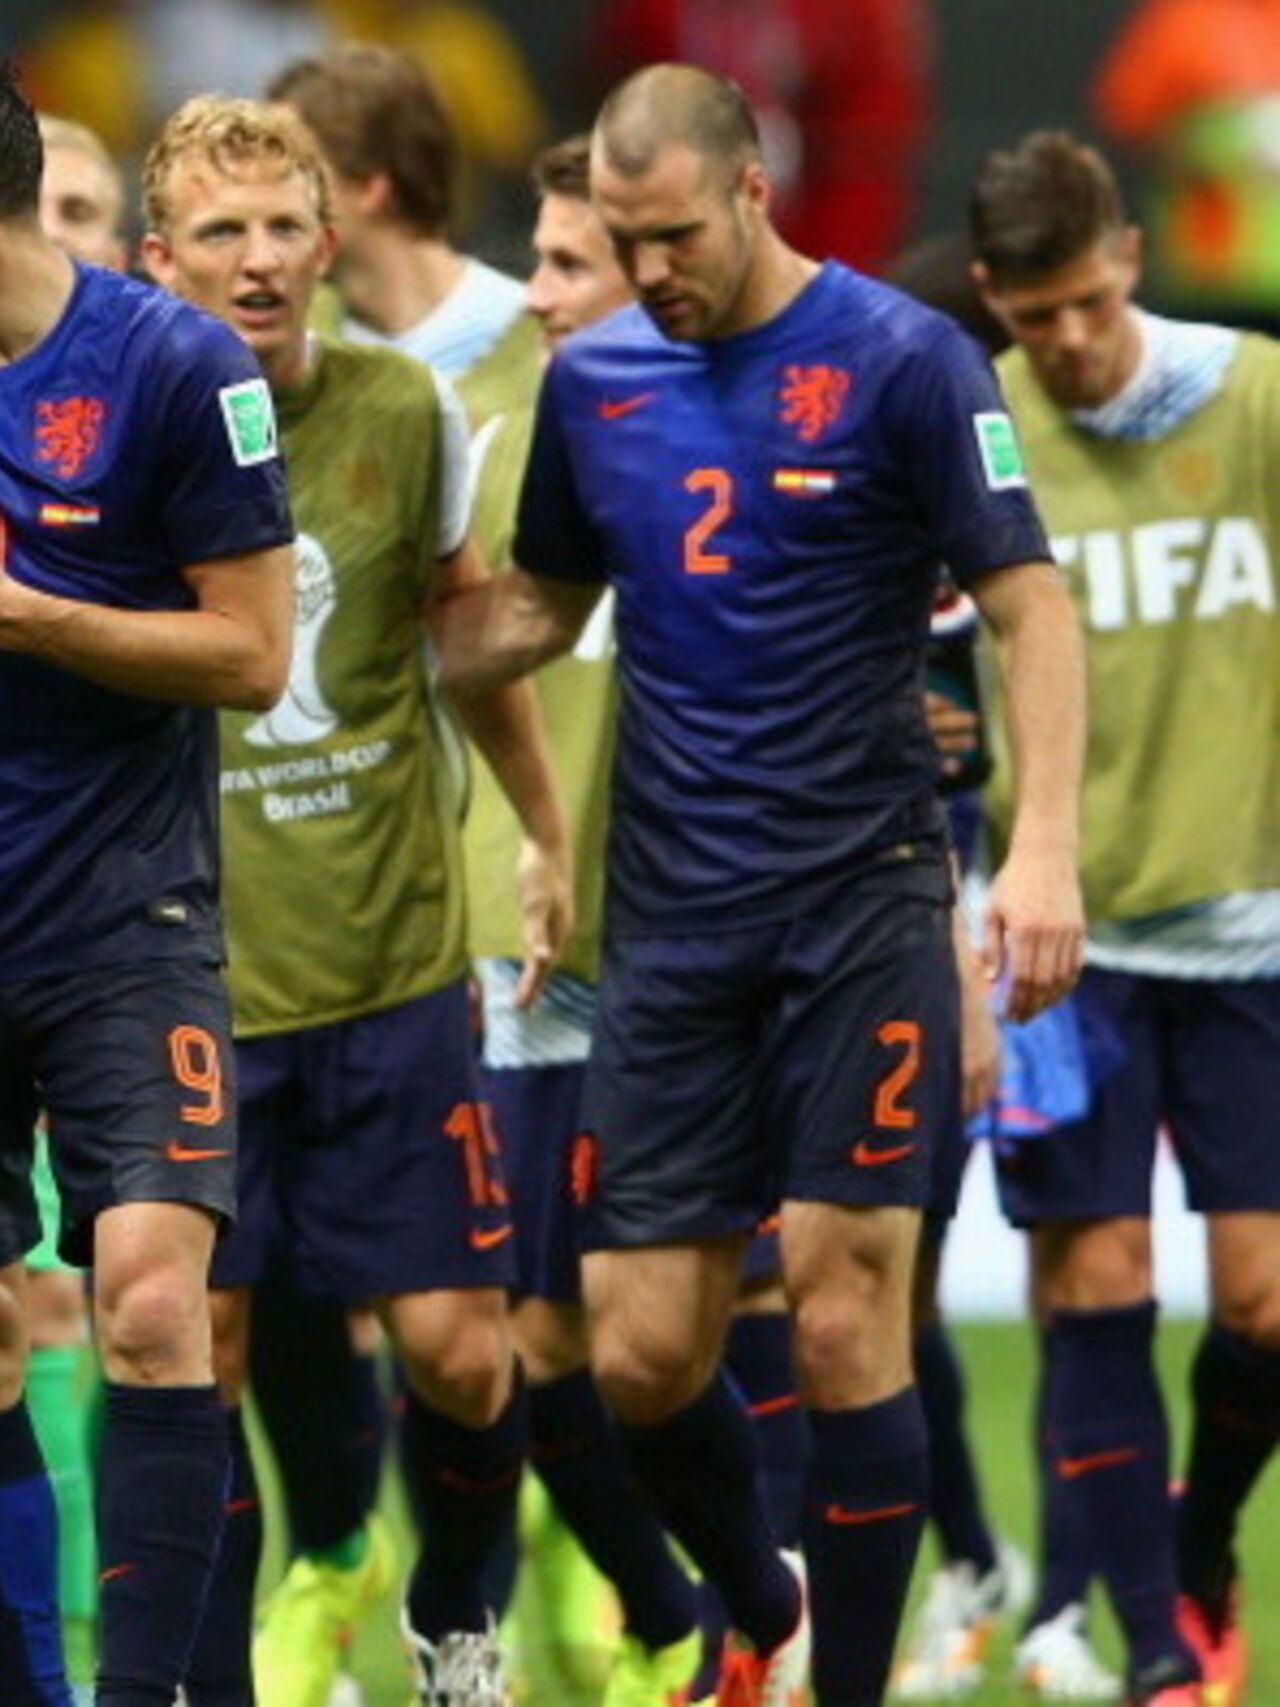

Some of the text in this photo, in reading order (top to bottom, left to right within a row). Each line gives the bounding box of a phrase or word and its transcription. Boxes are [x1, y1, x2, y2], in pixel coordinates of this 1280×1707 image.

[683, 470, 732, 572] 2
[257, 755, 348, 787] WORLD
[263, 781, 351, 821] Brasil
[168, 1026, 222, 1124] 9
[874, 1020, 920, 1127] 2
